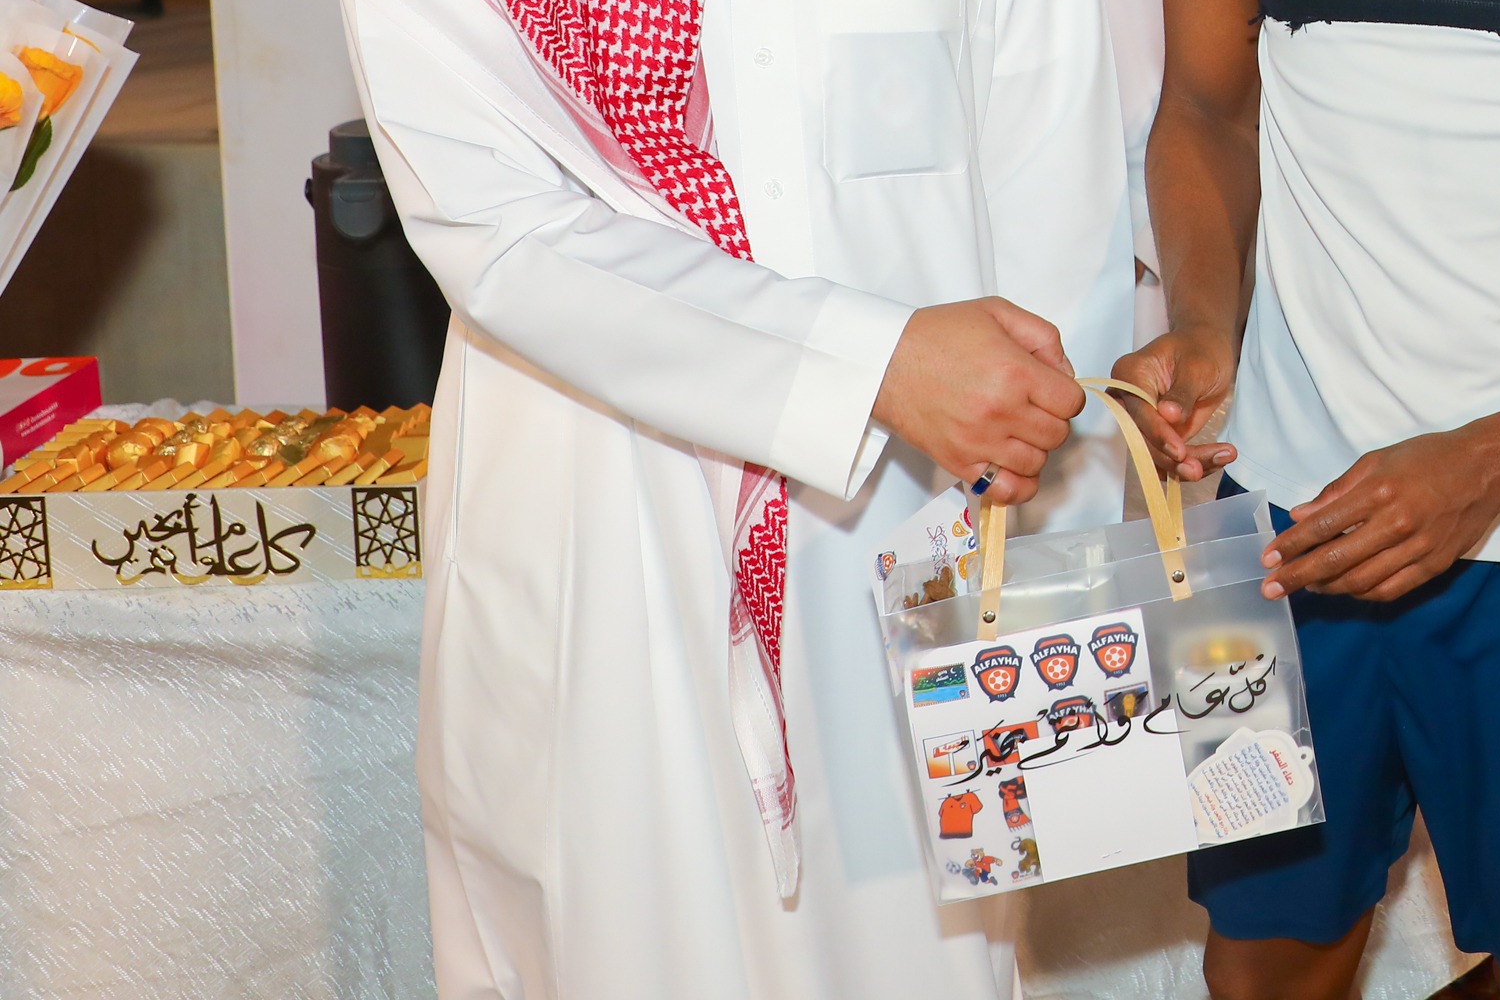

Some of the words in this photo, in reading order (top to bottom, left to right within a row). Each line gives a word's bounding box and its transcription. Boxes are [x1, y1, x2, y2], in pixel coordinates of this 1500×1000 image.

[1091, 633, 1136, 652] ALFAYHA
[1033, 645, 1079, 663] ALFAYHA
[973, 656, 1020, 675] ALFAYHA
[1269, 749, 1288, 770] السفر
[1282, 768, 1294, 786] دعاء
